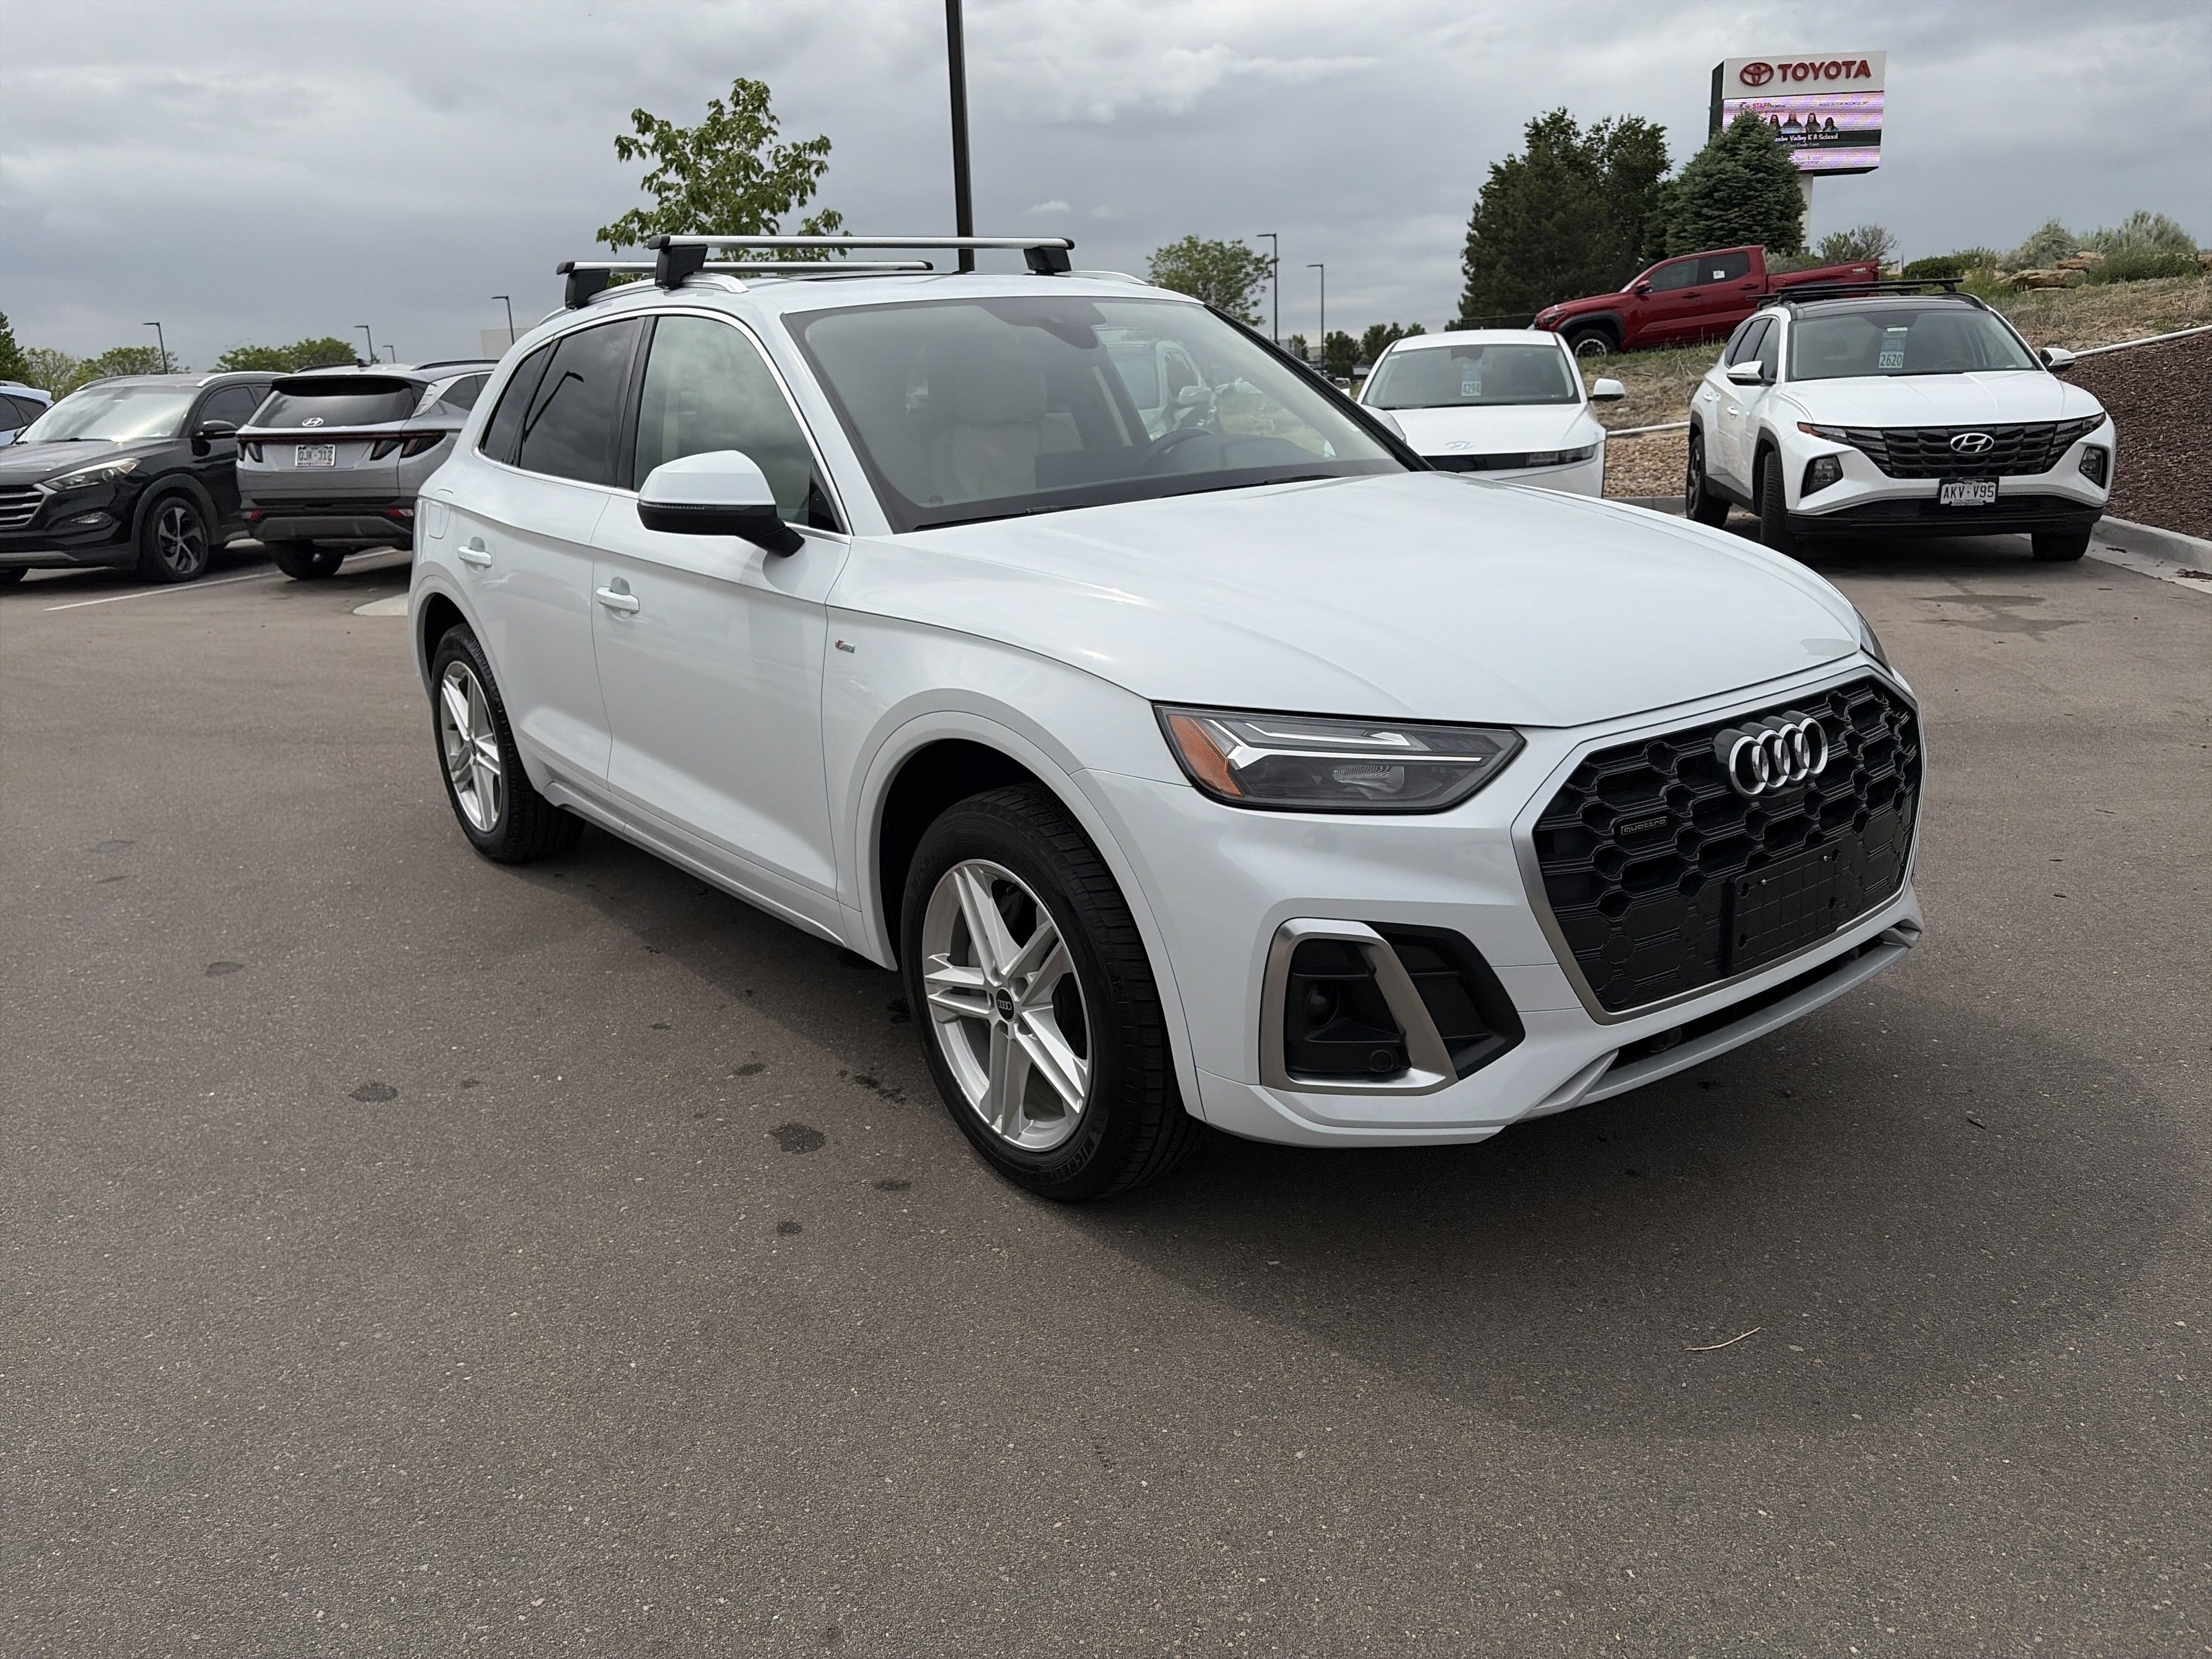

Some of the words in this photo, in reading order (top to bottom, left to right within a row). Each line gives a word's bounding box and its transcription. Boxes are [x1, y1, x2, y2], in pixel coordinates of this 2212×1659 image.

[1778, 60, 1871, 82] TOYOTA
[1880, 354, 1902, 366] 2620
[1624, 819, 1666, 833] quattro
